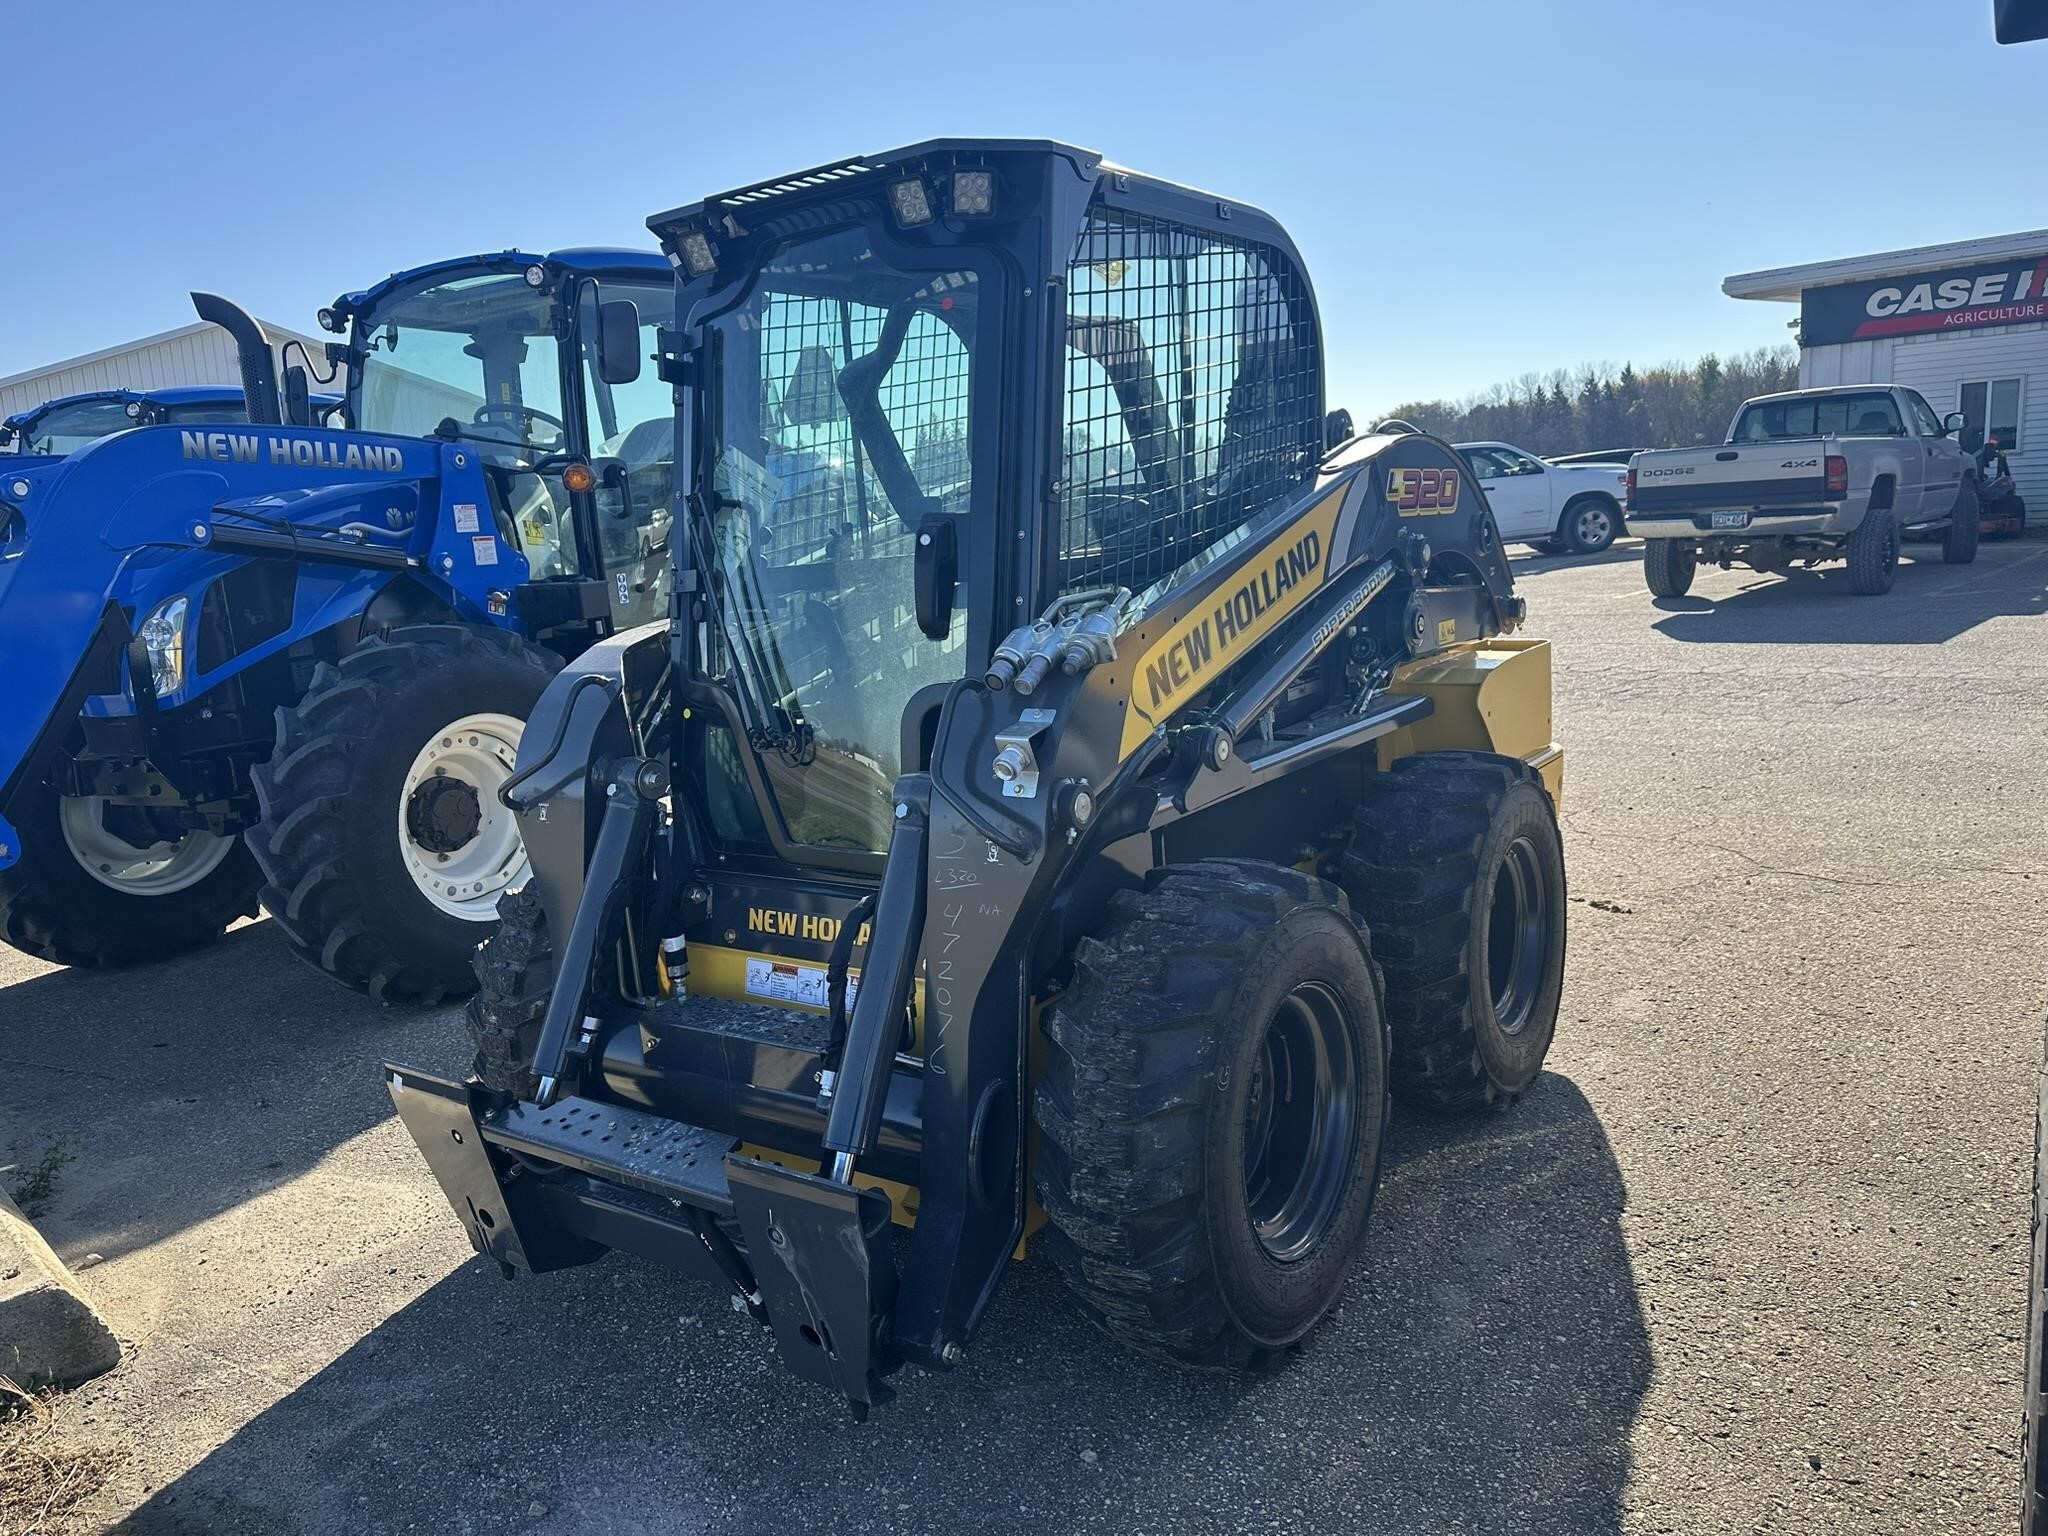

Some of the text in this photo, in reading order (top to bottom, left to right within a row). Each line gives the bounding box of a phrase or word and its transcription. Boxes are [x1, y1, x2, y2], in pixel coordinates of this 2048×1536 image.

[1866, 271, 2009, 317] CASE
[1944, 304, 2045, 326] AGRICULTURE
[181, 431, 403, 473] NEW HOLLAND
[1643, 467, 1696, 478] DODGE
[1145, 529, 1322, 709] NEW HOLLAND
[934, 868, 977, 884] L320
[748, 907, 798, 937] NEW
